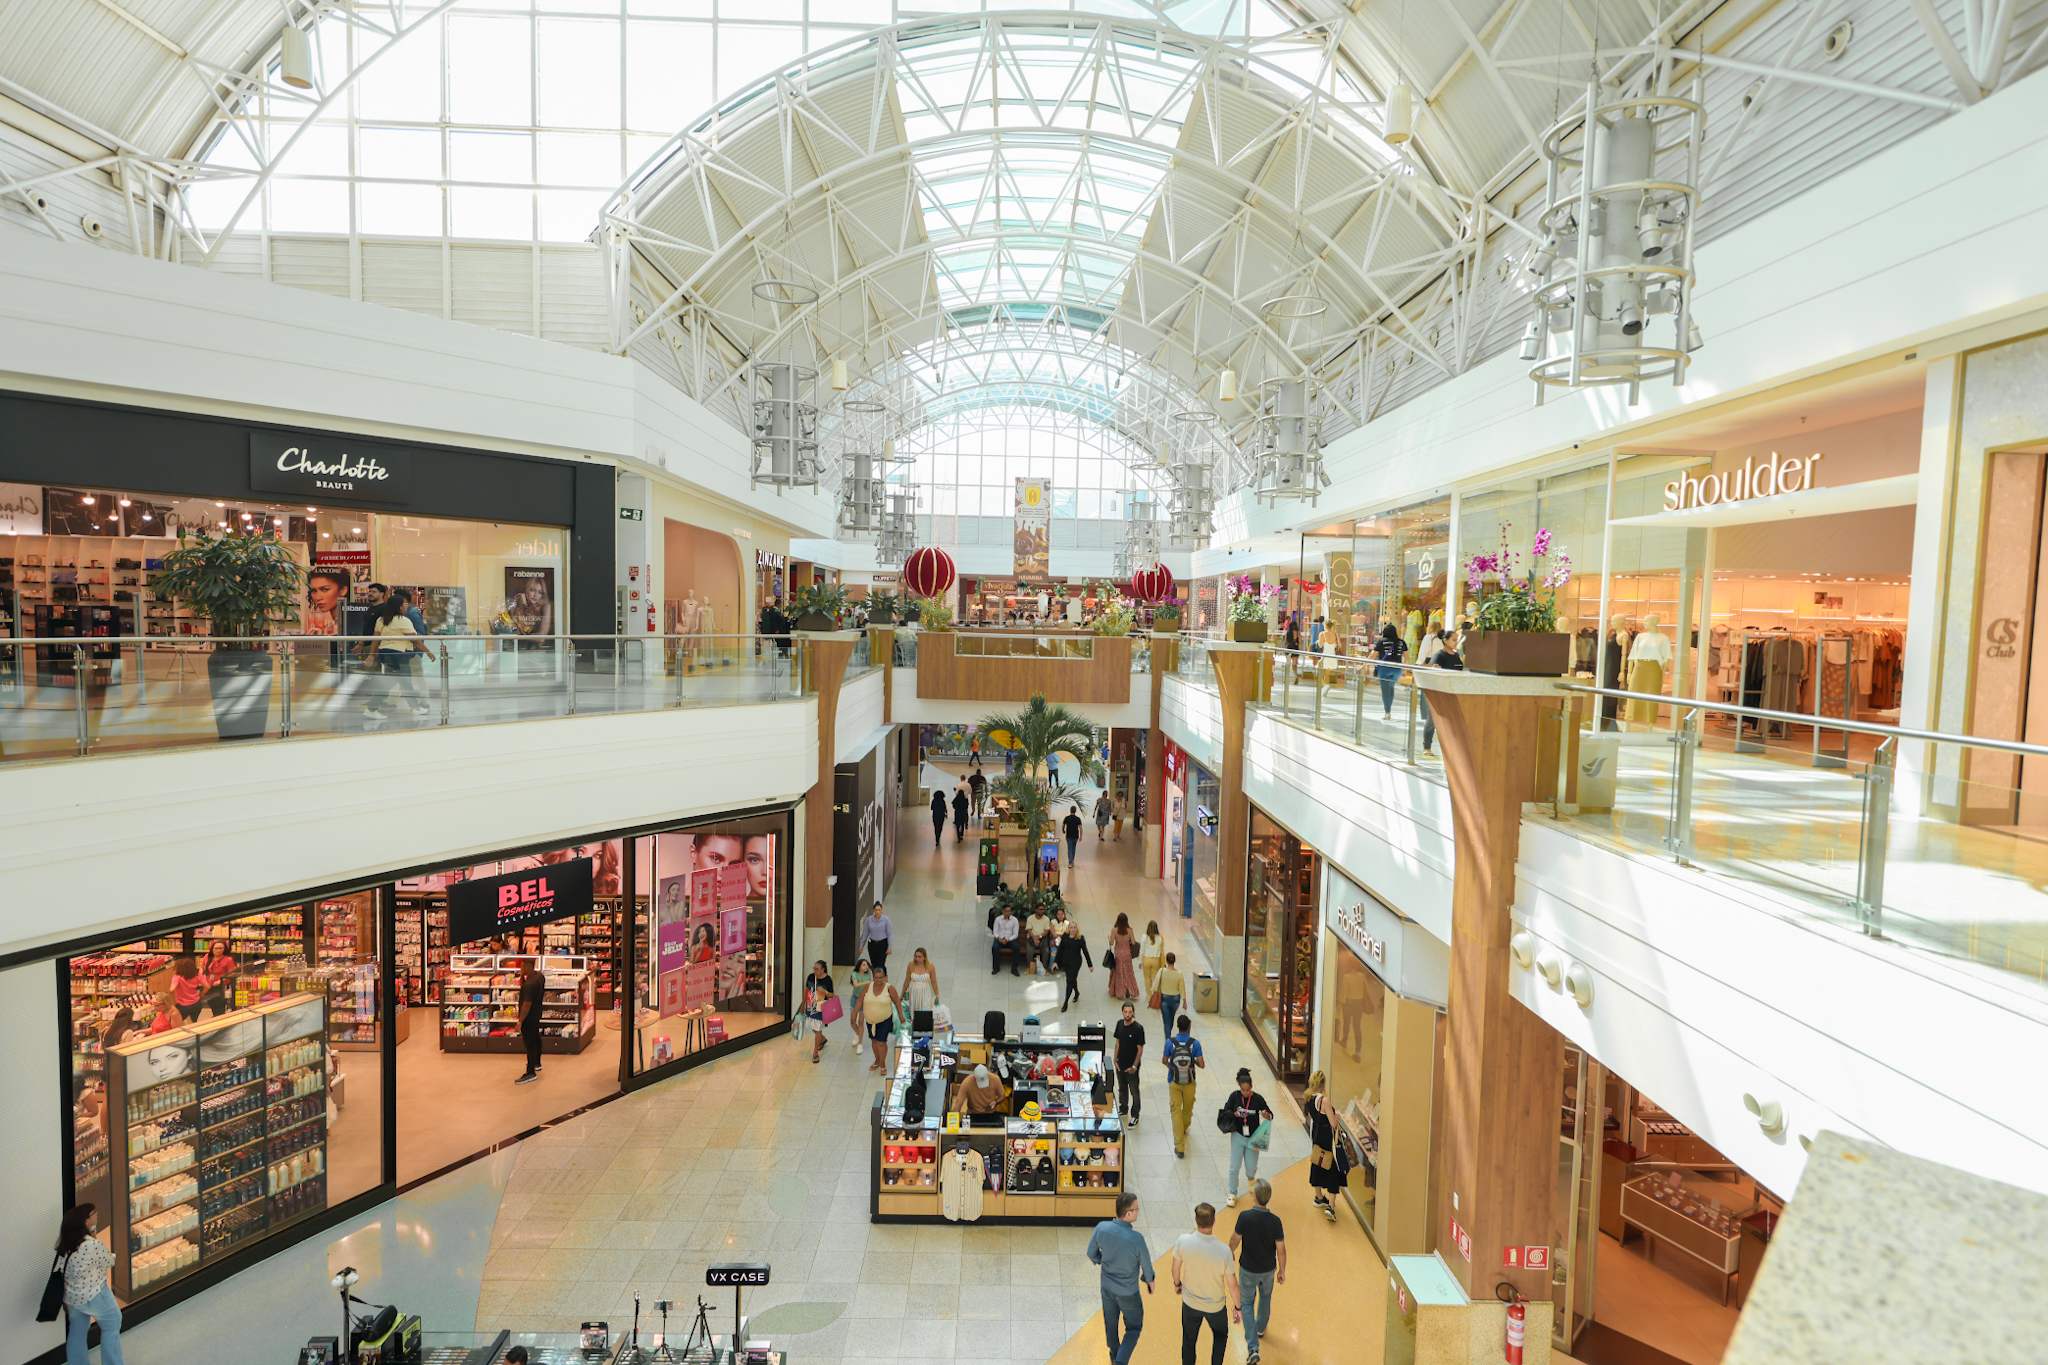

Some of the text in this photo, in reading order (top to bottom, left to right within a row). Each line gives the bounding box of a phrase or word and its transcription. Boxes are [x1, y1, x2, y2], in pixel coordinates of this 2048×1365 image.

[276, 447, 389, 480] Charlotte
[1663, 451, 1822, 511] shoulder
[758, 549, 784, 569] ZINZANE
[513, 570, 545, 578] rabanne
[1987, 618, 2019, 644] CS
[1986, 646, 2015, 658] Club
[498, 877, 555, 907] BEL
[497, 898, 553, 918] Cosméticos
[497, 908, 554, 925] SALVADOR
[1337, 905, 1382, 963] Rommanel
[711, 1273, 765, 1282] VX CASE
